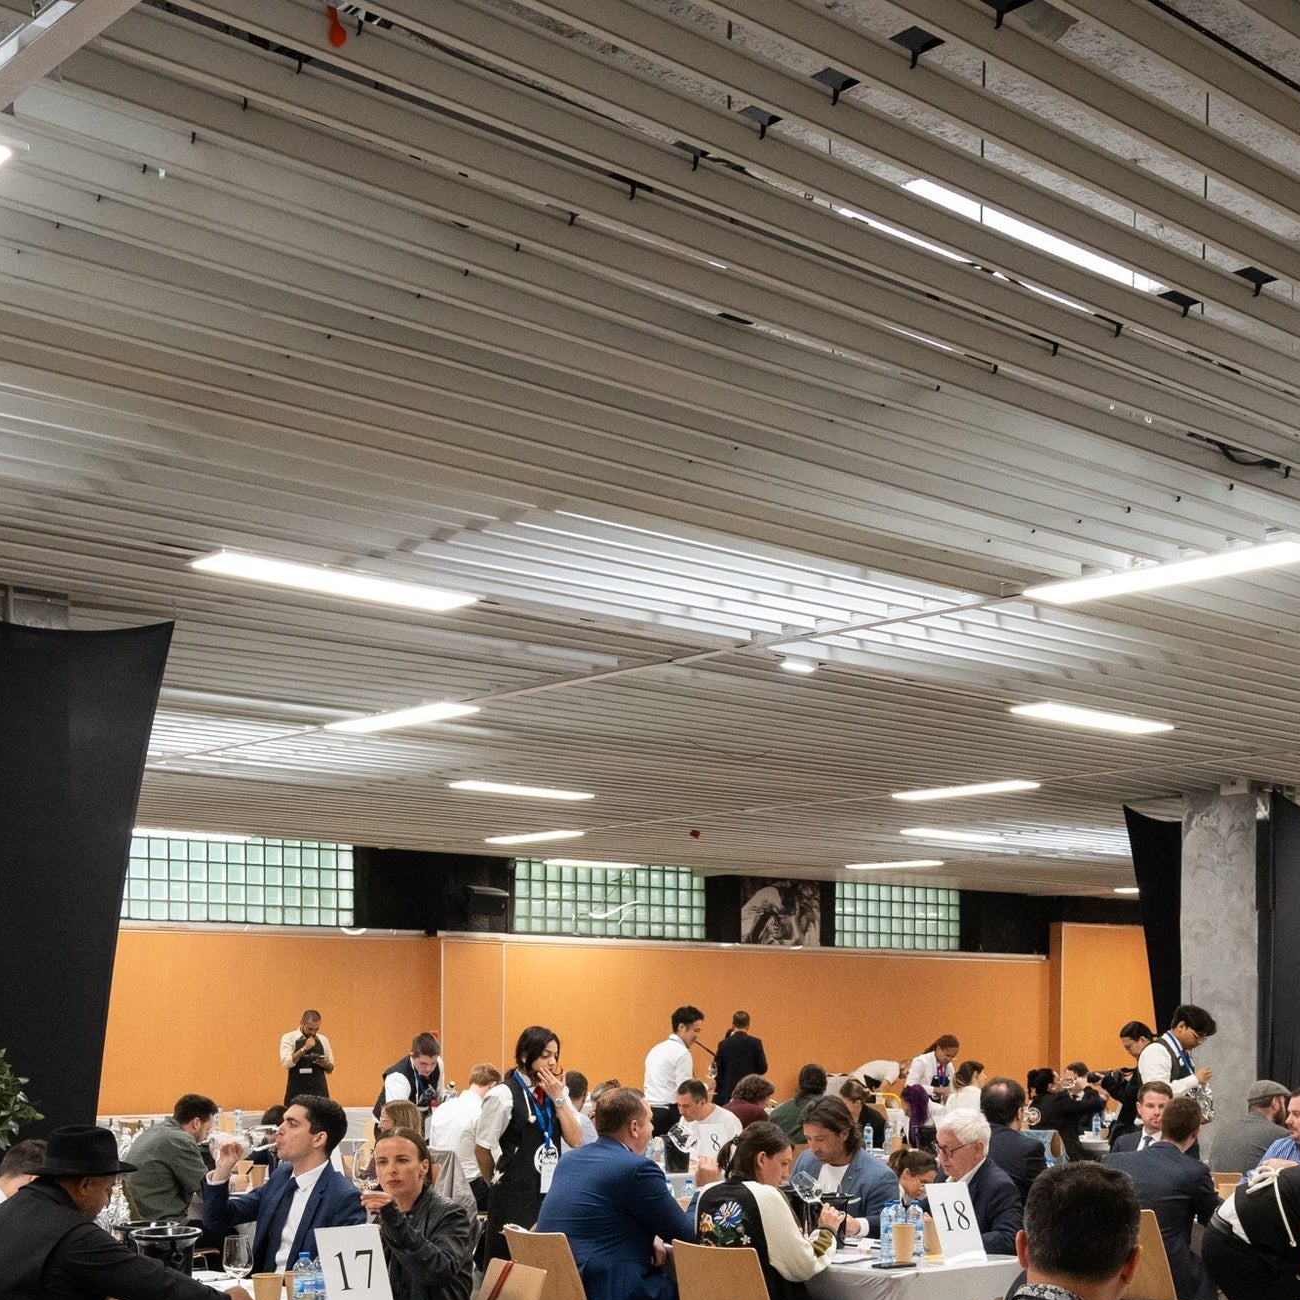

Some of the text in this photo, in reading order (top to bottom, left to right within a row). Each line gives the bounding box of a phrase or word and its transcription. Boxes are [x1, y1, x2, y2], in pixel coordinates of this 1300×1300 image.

[710, 1133, 721, 1152] 8
[940, 1200, 971, 1231] 18
[333, 1249, 373, 1291] 17
